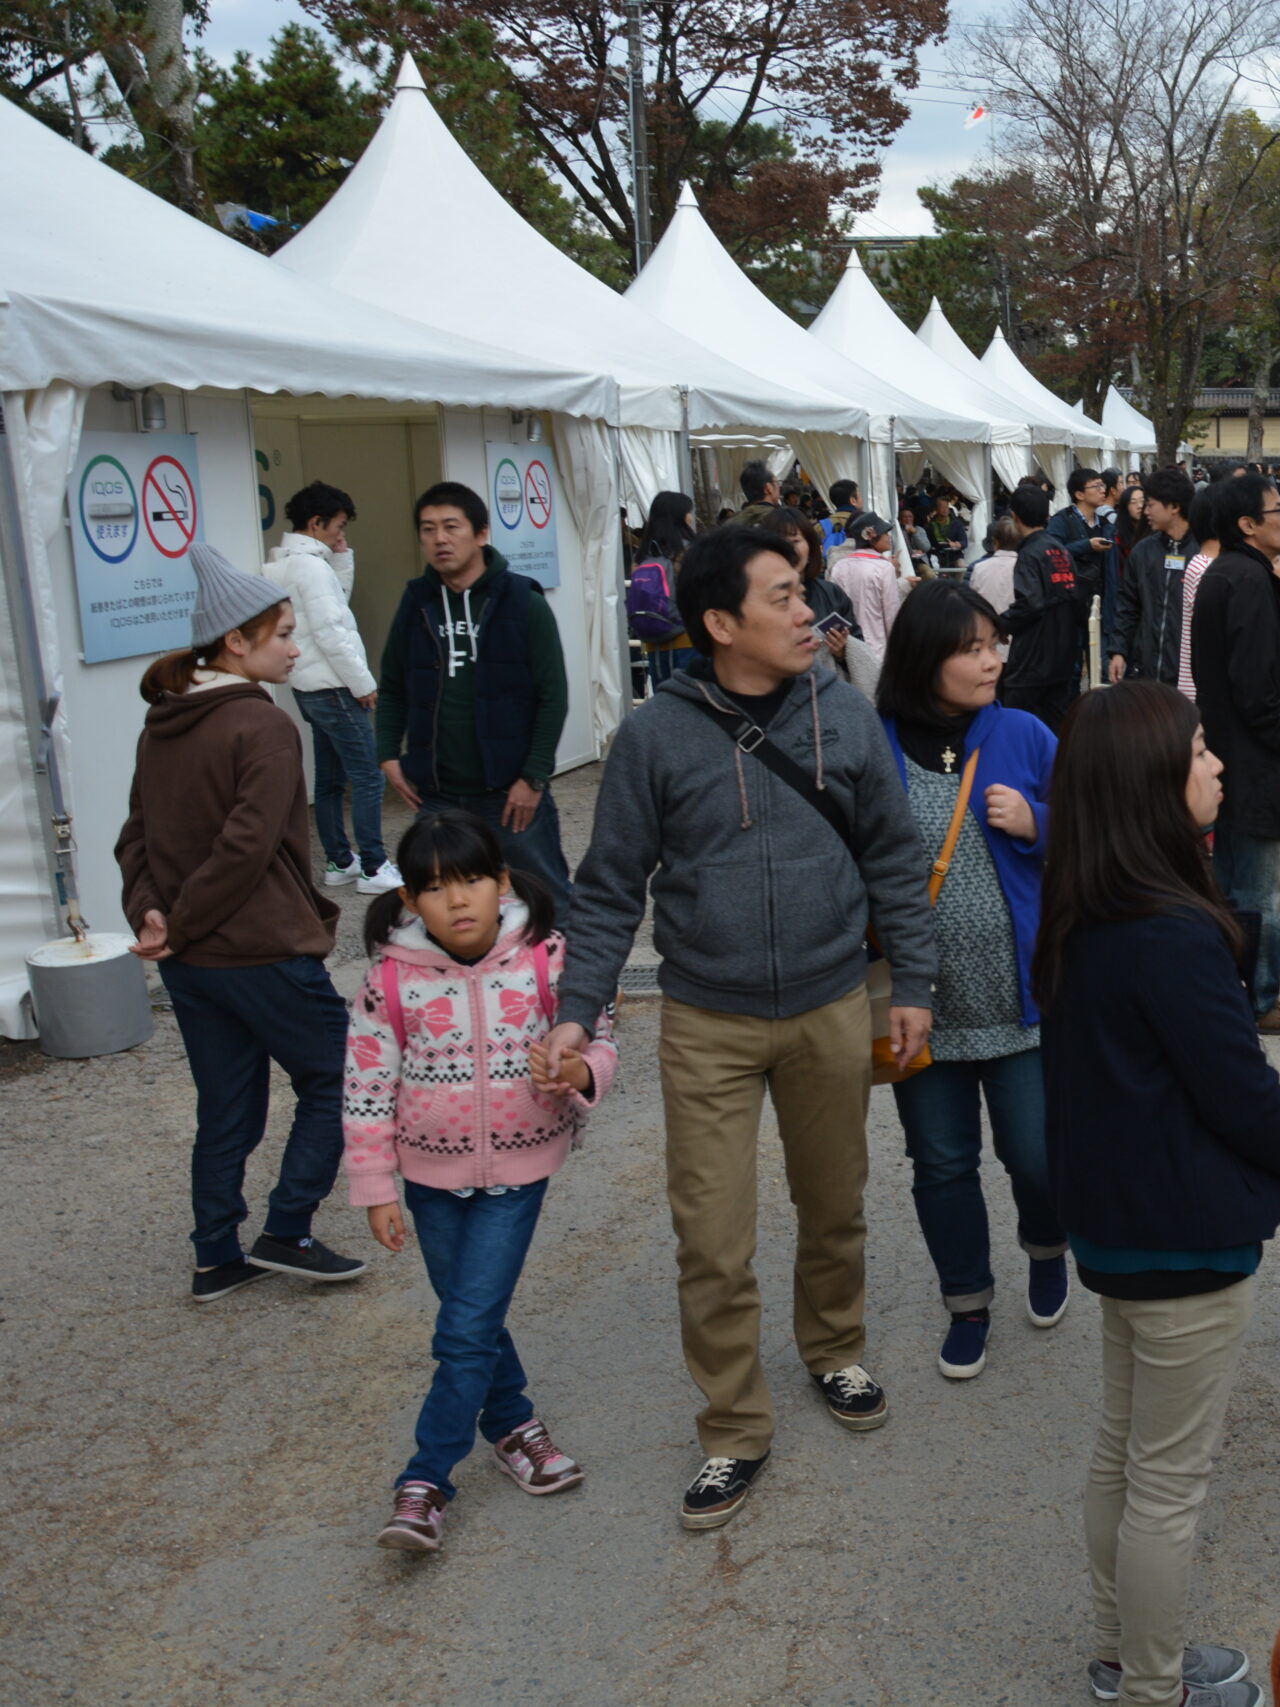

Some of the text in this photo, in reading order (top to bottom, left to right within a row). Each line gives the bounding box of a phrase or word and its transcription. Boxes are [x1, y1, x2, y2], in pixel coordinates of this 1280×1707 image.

[91, 481, 124, 496] IQOS
[96, 524, 128, 540] 使えます
